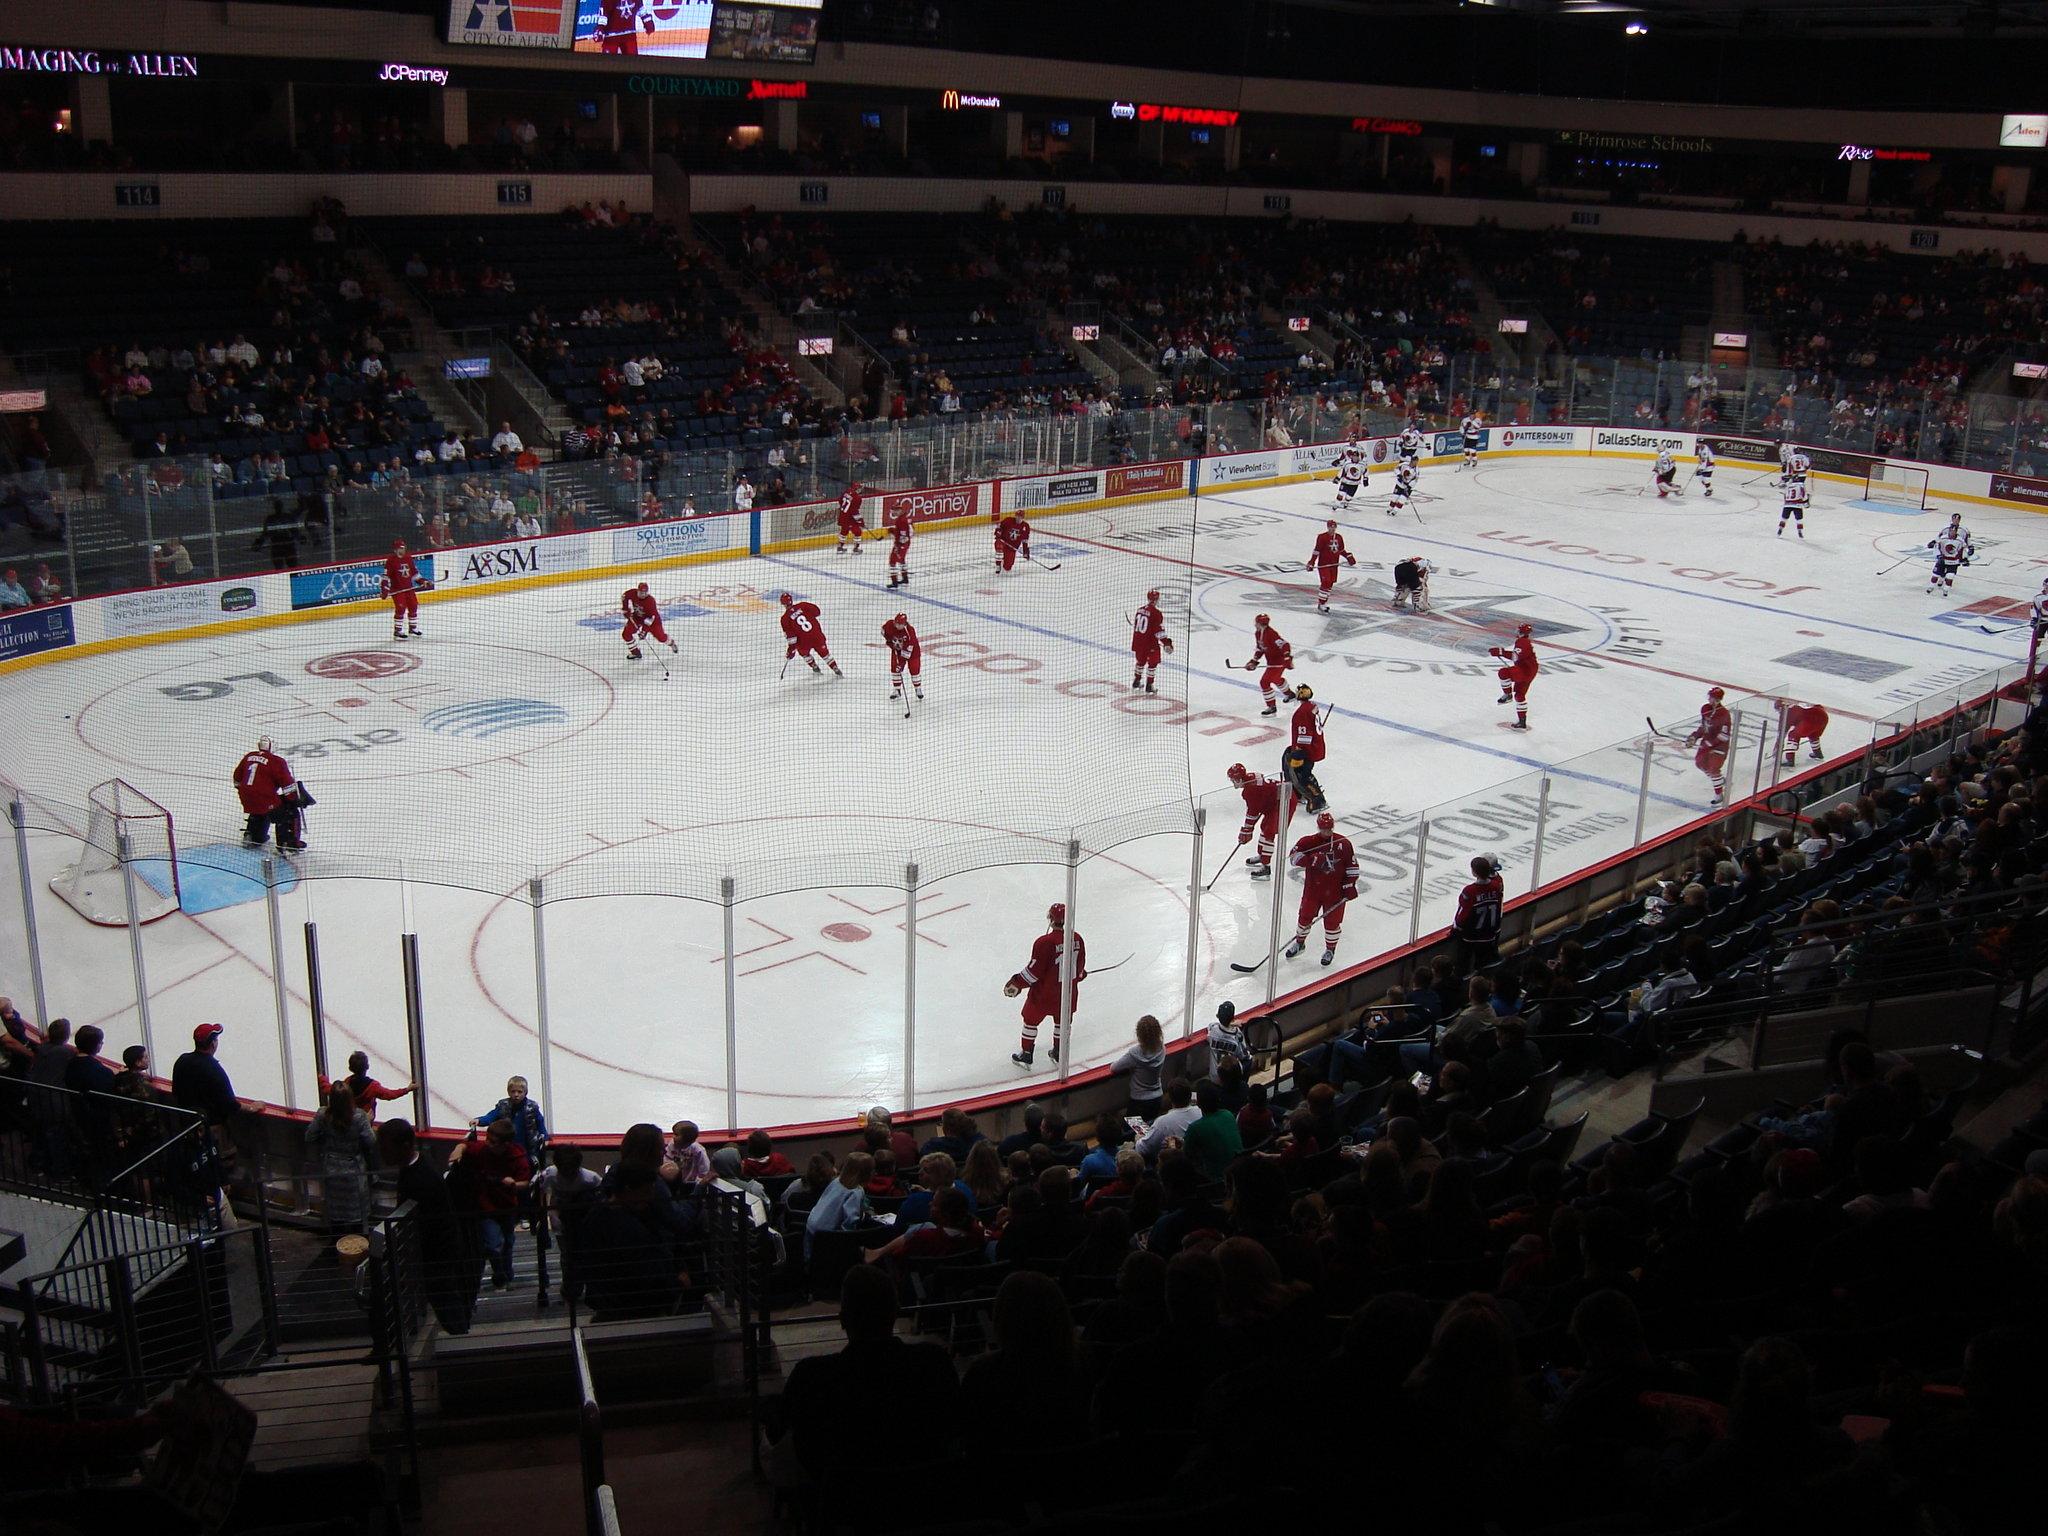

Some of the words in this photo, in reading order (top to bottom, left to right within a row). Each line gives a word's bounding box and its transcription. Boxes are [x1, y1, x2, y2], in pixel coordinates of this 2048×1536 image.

[463, 31, 493, 46] CITY
[497, 34, 515, 46] OF
[519, 36, 560, 49] ALLEN
[0, 47, 101, 74] IMAGING
[128, 54, 198, 77] ALLEN
[379, 65, 449, 86] JCPenney
[628, 76, 740, 97] COURTYARD
[960, 94, 1000, 109] McDonald's
[1138, 104, 1160, 121] OF
[1577, 131, 1648, 149] Primrose
[1651, 135, 1713, 153] Schools
[1837, 145, 1874, 161] Rose
[123, 187, 153, 205] 114
[502, 185, 526, 201] 115
[804, 185, 824, 201] 116
[1915, 232, 1934, 247] 120
[1515, 431, 1574, 441] PATTERSON-UTI
[1597, 432, 1683, 450] DallasStarscom
[1228, 463, 1262, 475] ViewPoint
[636, 522, 706, 541] SOLUTIONS
[113, 597, 138, 610] BRING
[141, 594, 165, 606] YOUR
[180, 589, 208, 600] GAME
[795, 615, 814, 632] 8
[1134, 614, 1149, 634] 10
[1588, 604, 1664, 659] ALLEN
[158, 669, 293, 703] LG
[279, 727, 406, 761] at&
[247, 763, 259, 786] 1
[1336, 803, 1418, 836] THE
[1498, 811, 1630, 872] PARTMENTS
[1475, 903, 1498, 930] 71
